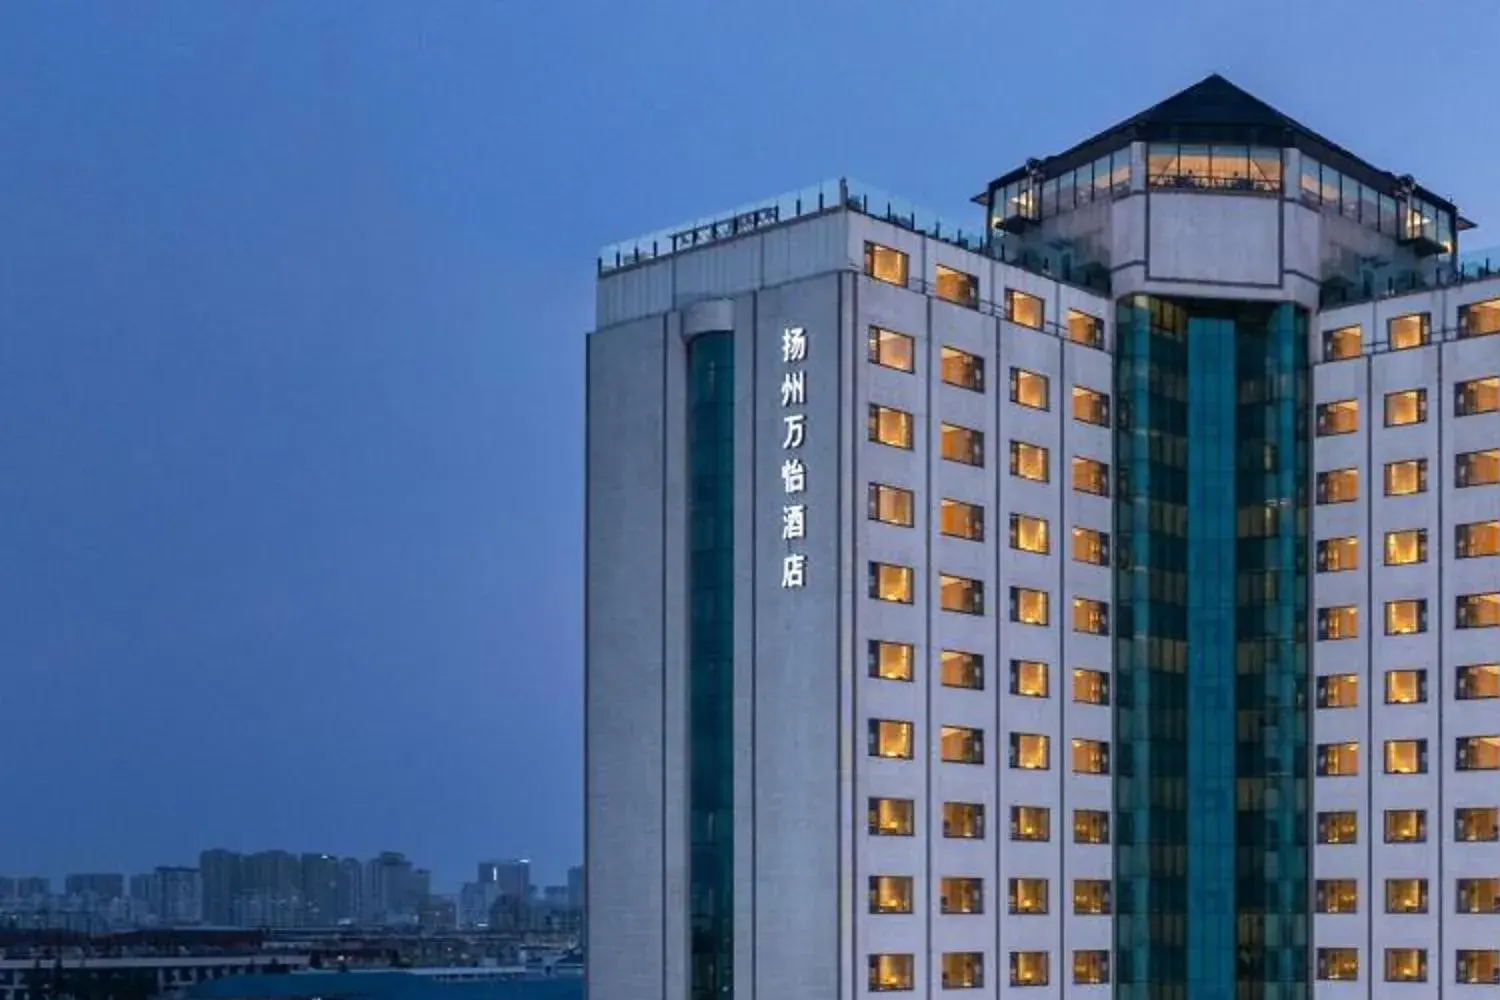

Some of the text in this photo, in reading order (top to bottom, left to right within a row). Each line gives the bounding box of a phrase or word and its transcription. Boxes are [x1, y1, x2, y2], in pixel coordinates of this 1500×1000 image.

[781, 327, 807, 588] 扬州万怡酒店
